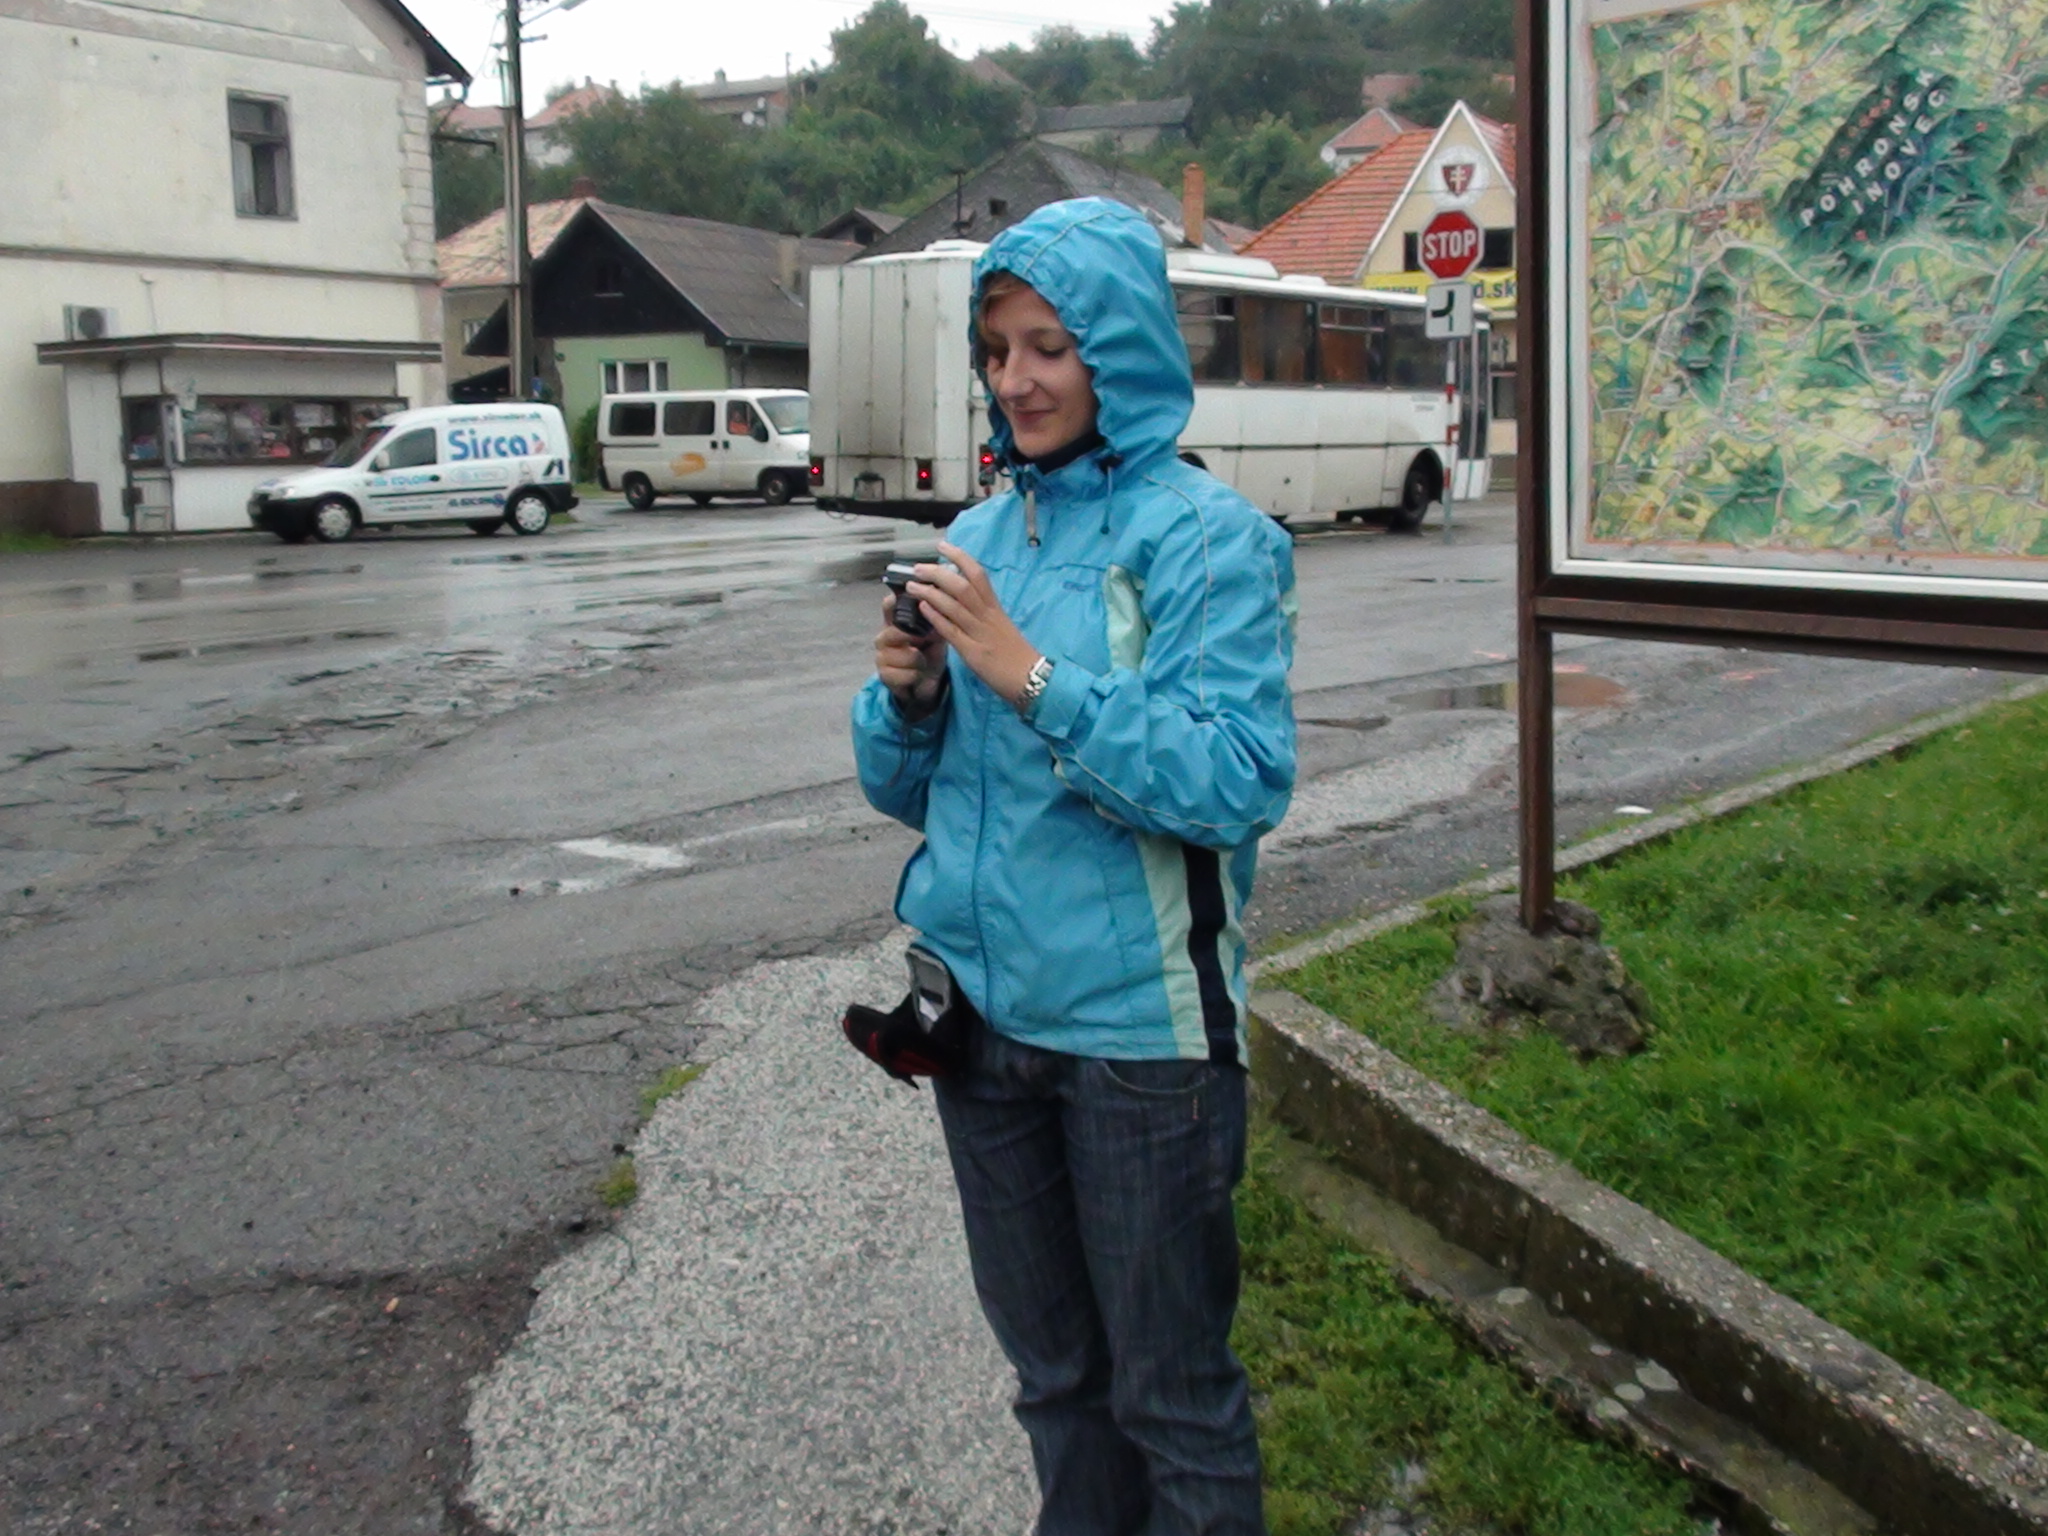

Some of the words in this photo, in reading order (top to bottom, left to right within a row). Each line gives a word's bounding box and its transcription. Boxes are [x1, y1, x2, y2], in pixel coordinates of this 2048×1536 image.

[1852, 89, 1944, 214] INOVEC
[1425, 229, 1476, 260] STOP
[448, 428, 528, 461] Sirca
